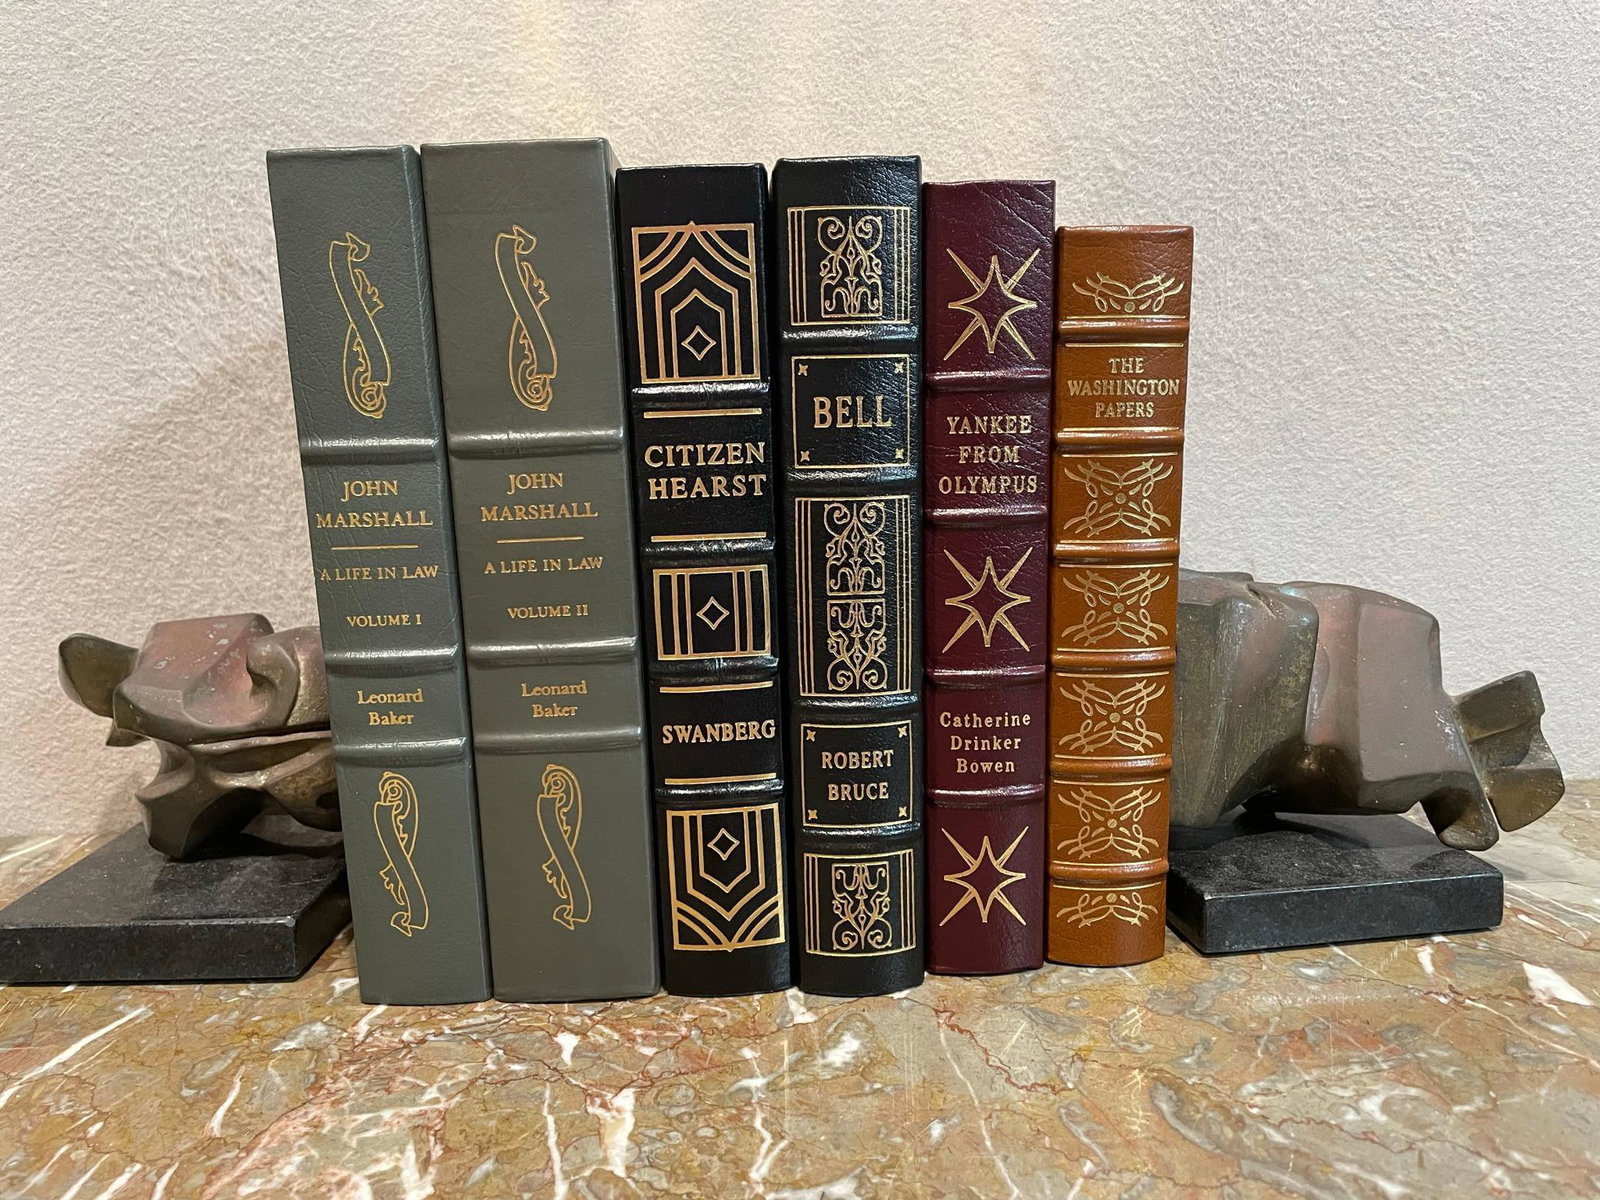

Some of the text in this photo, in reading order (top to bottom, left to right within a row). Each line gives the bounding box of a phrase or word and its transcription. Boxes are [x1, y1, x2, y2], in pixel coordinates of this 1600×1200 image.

[1109, 358, 1145, 374] THE
[1067, 379, 1180, 397] WASHINGTON
[813, 395, 893, 429] BELL
[1095, 402, 1155, 418] PAPERS
[947, 415, 1032, 434] YANKEE
[644, 442, 766, 468] CITIZEN
[959, 445, 1021, 464] FROM
[341, 480, 399, 502] JOHN
[507, 473, 564, 495] JOHN
[648, 474, 767, 500] HEARST
[938, 475, 1038, 494] OLYMPUS
[316, 510, 434, 529] MARSHALL
[480, 502, 598, 521] MARSHALL
[320, 565, 439, 581] A LIFE IN LAW
[484, 556, 604, 574] A LIFE IN LAW
[507, 604, 589, 619] VOLUME II
[346, 614, 422, 628] VOLUME I
[357, 688, 424, 704] Leonard
[521, 680, 588, 697] Leonard
[369, 712, 414, 725] Baker
[532, 704, 578, 718] Baker
[939, 711, 1031, 728] Catherine
[662, 719, 777, 744] SWANBERG
[950, 735, 1022, 751] Drinker
[821, 750, 894, 769] ROBERT
[956, 758, 1016, 773] Bowen
[828, 782, 889, 800] BRUCE
